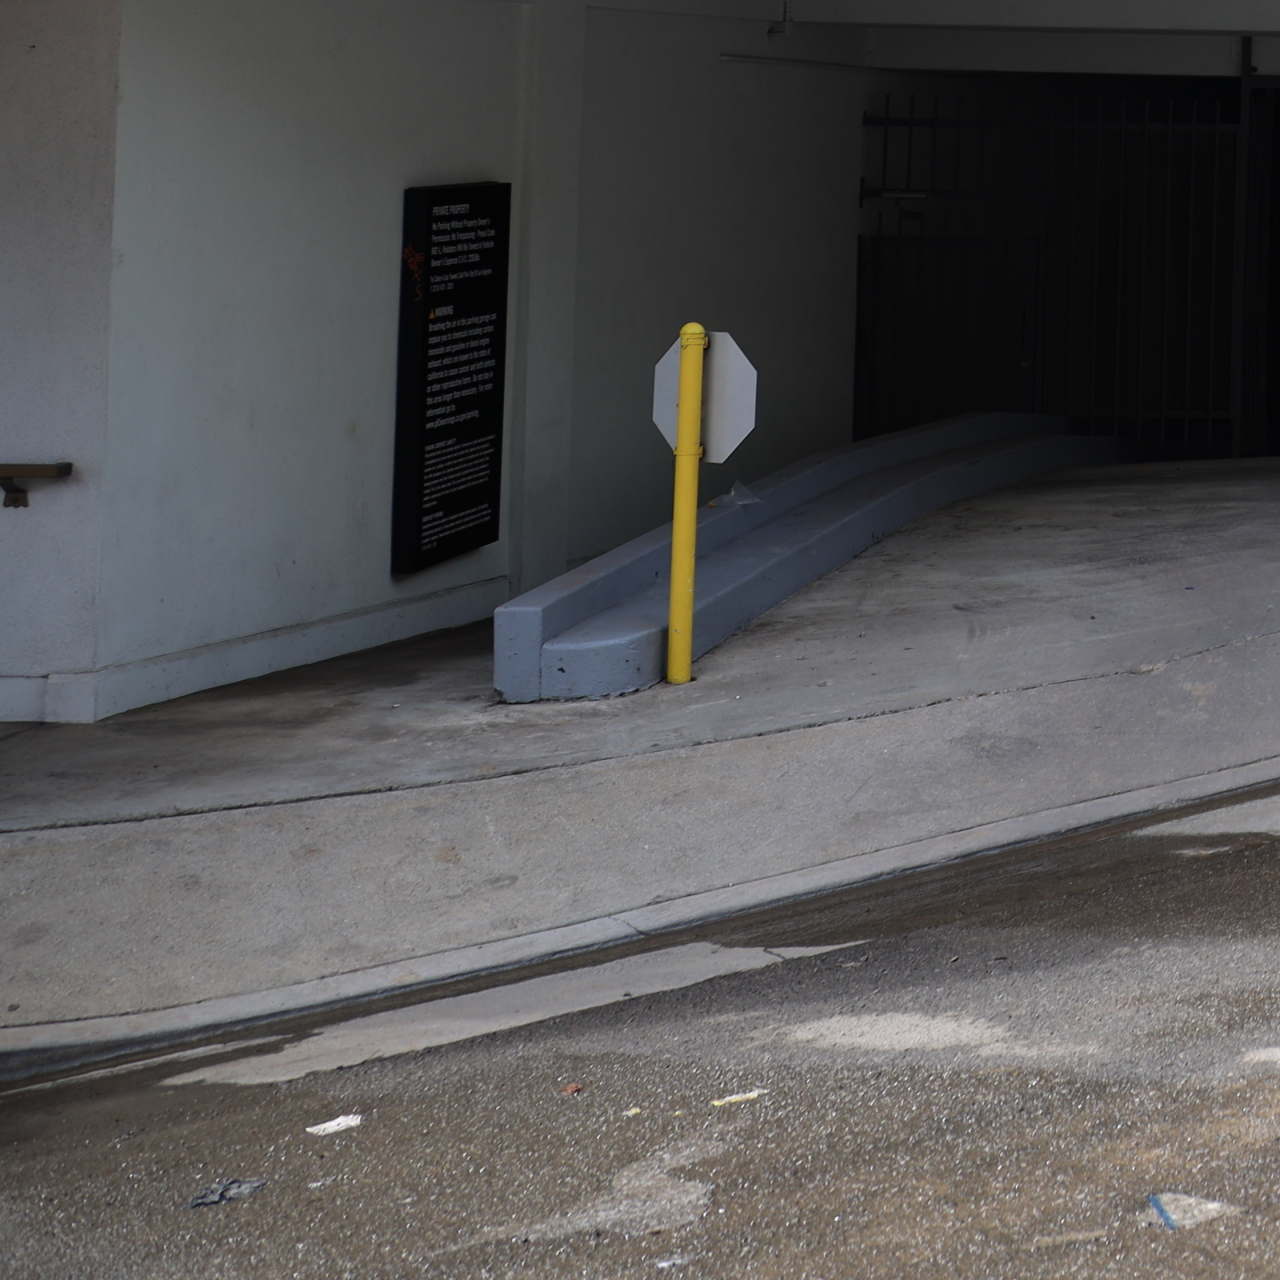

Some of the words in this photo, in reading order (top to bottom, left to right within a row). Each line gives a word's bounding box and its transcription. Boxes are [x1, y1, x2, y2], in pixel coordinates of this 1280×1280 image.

[433, 206, 449, 216] PRIVATE
[449, 204, 470, 214] PROPERTY
[435, 305, 453, 317] WARNING
